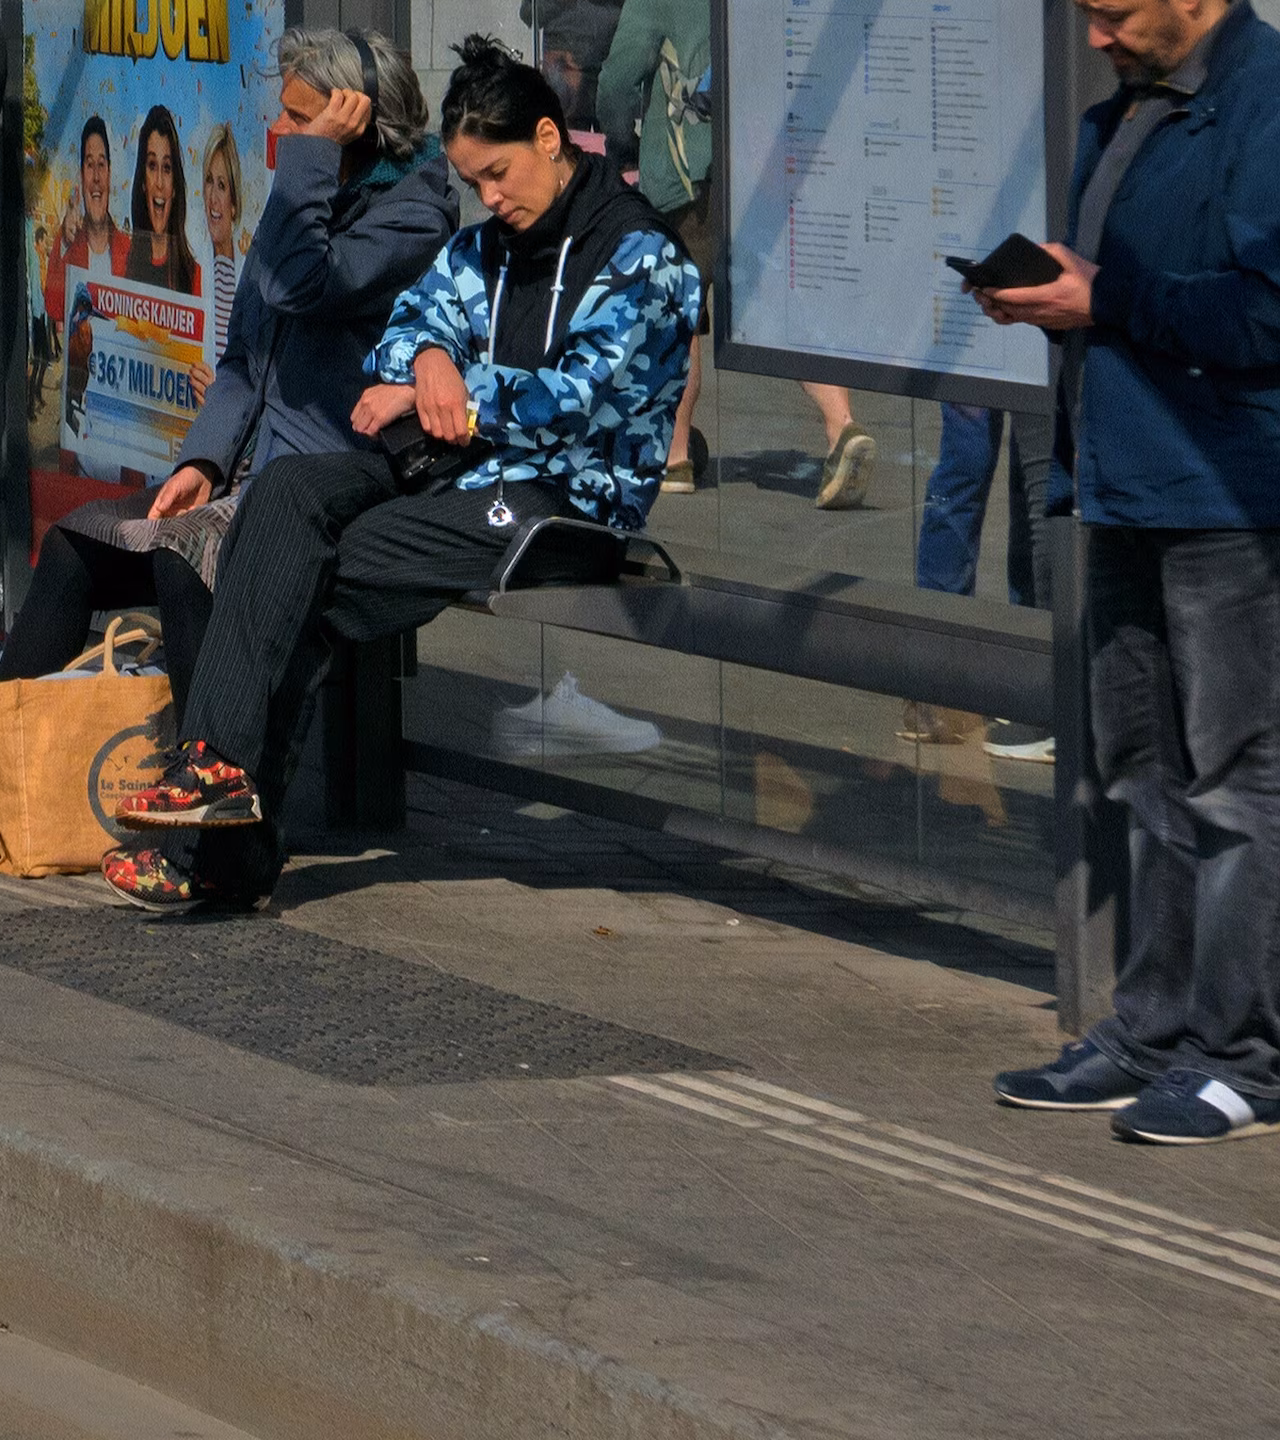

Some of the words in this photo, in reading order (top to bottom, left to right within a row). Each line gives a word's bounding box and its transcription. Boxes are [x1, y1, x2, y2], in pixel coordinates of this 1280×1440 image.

[97, 287, 195, 336] KONINGSKANJER
[129, 358, 198, 412] MILJOEN
[100, 778, 114, 791] Le
